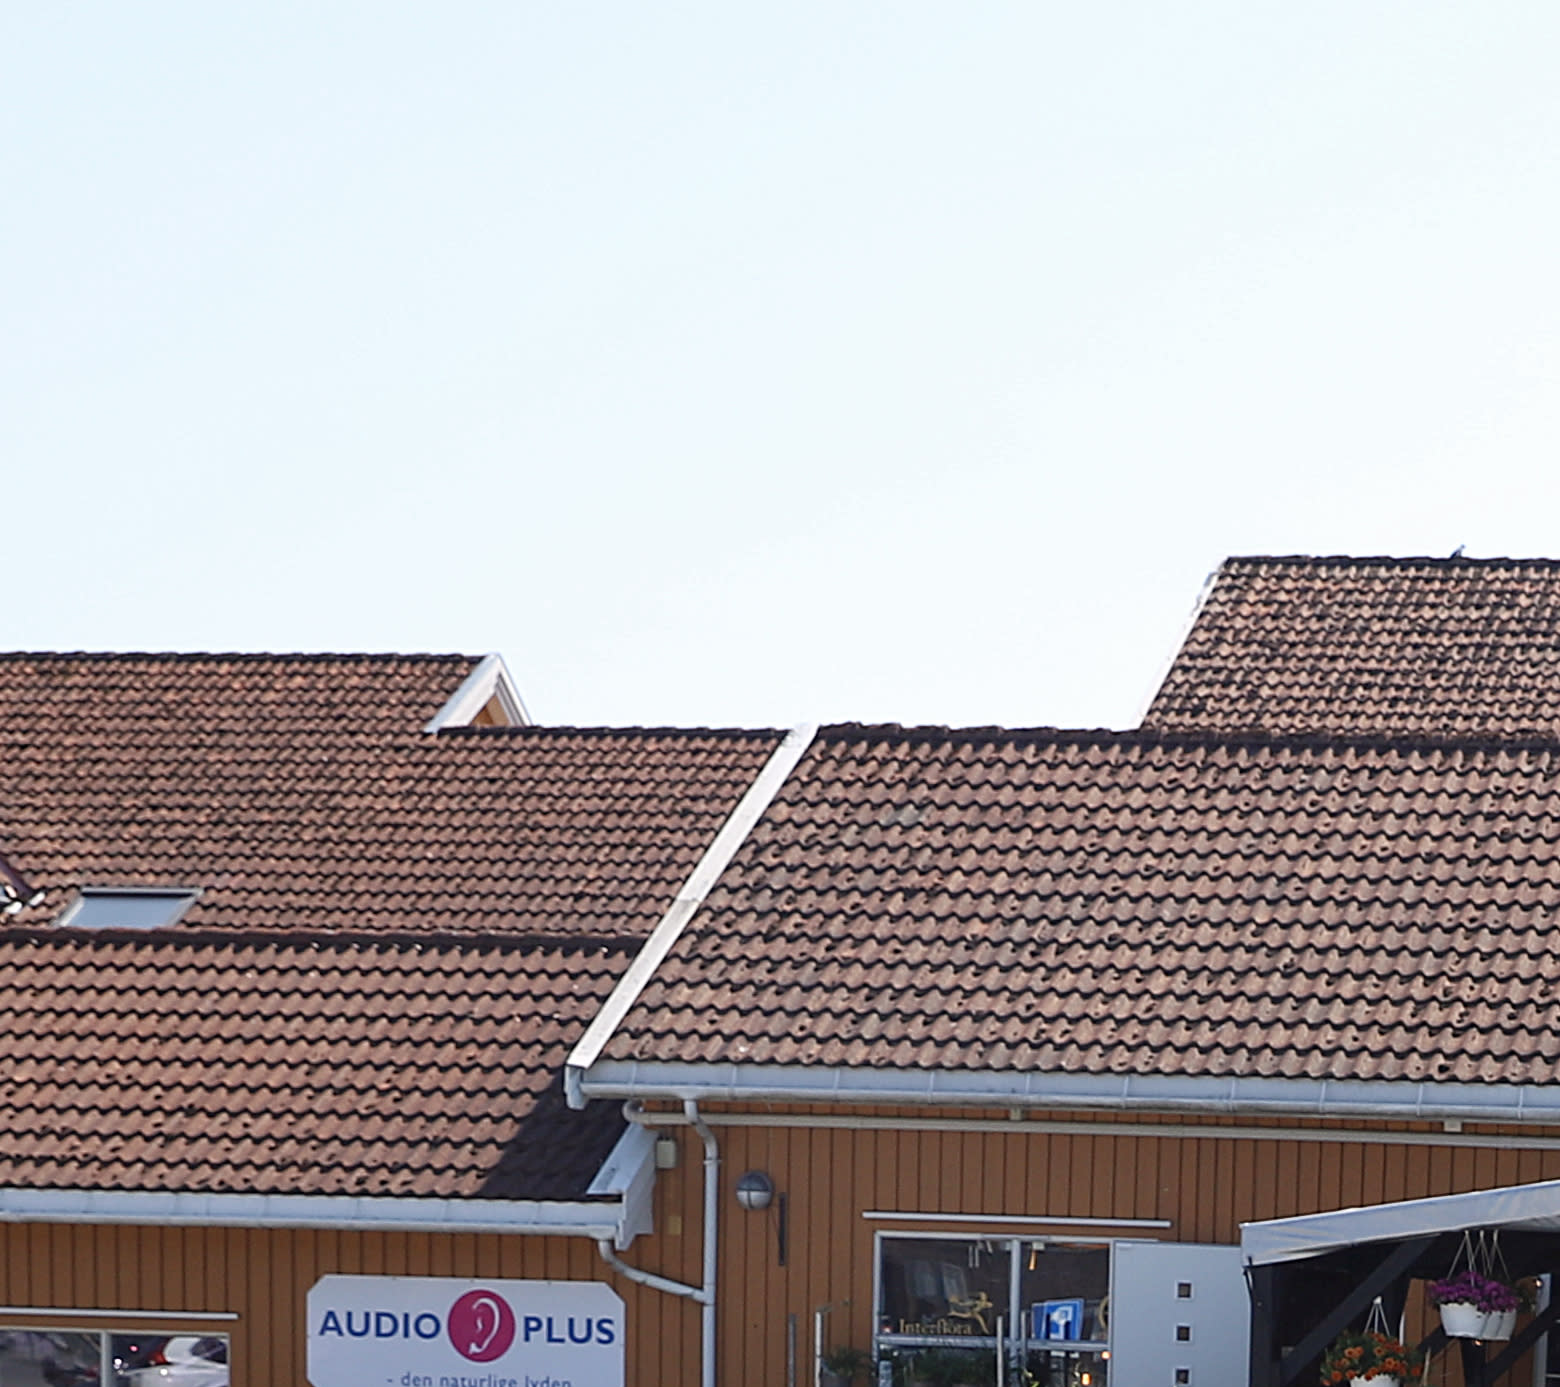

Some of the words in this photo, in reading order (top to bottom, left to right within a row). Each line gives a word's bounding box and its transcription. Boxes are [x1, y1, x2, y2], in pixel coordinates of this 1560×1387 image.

[318, 1310, 441, 1339] AUDIO
[522, 1315, 615, 1345] PLUS
[401, 1372, 433, 1387] den
